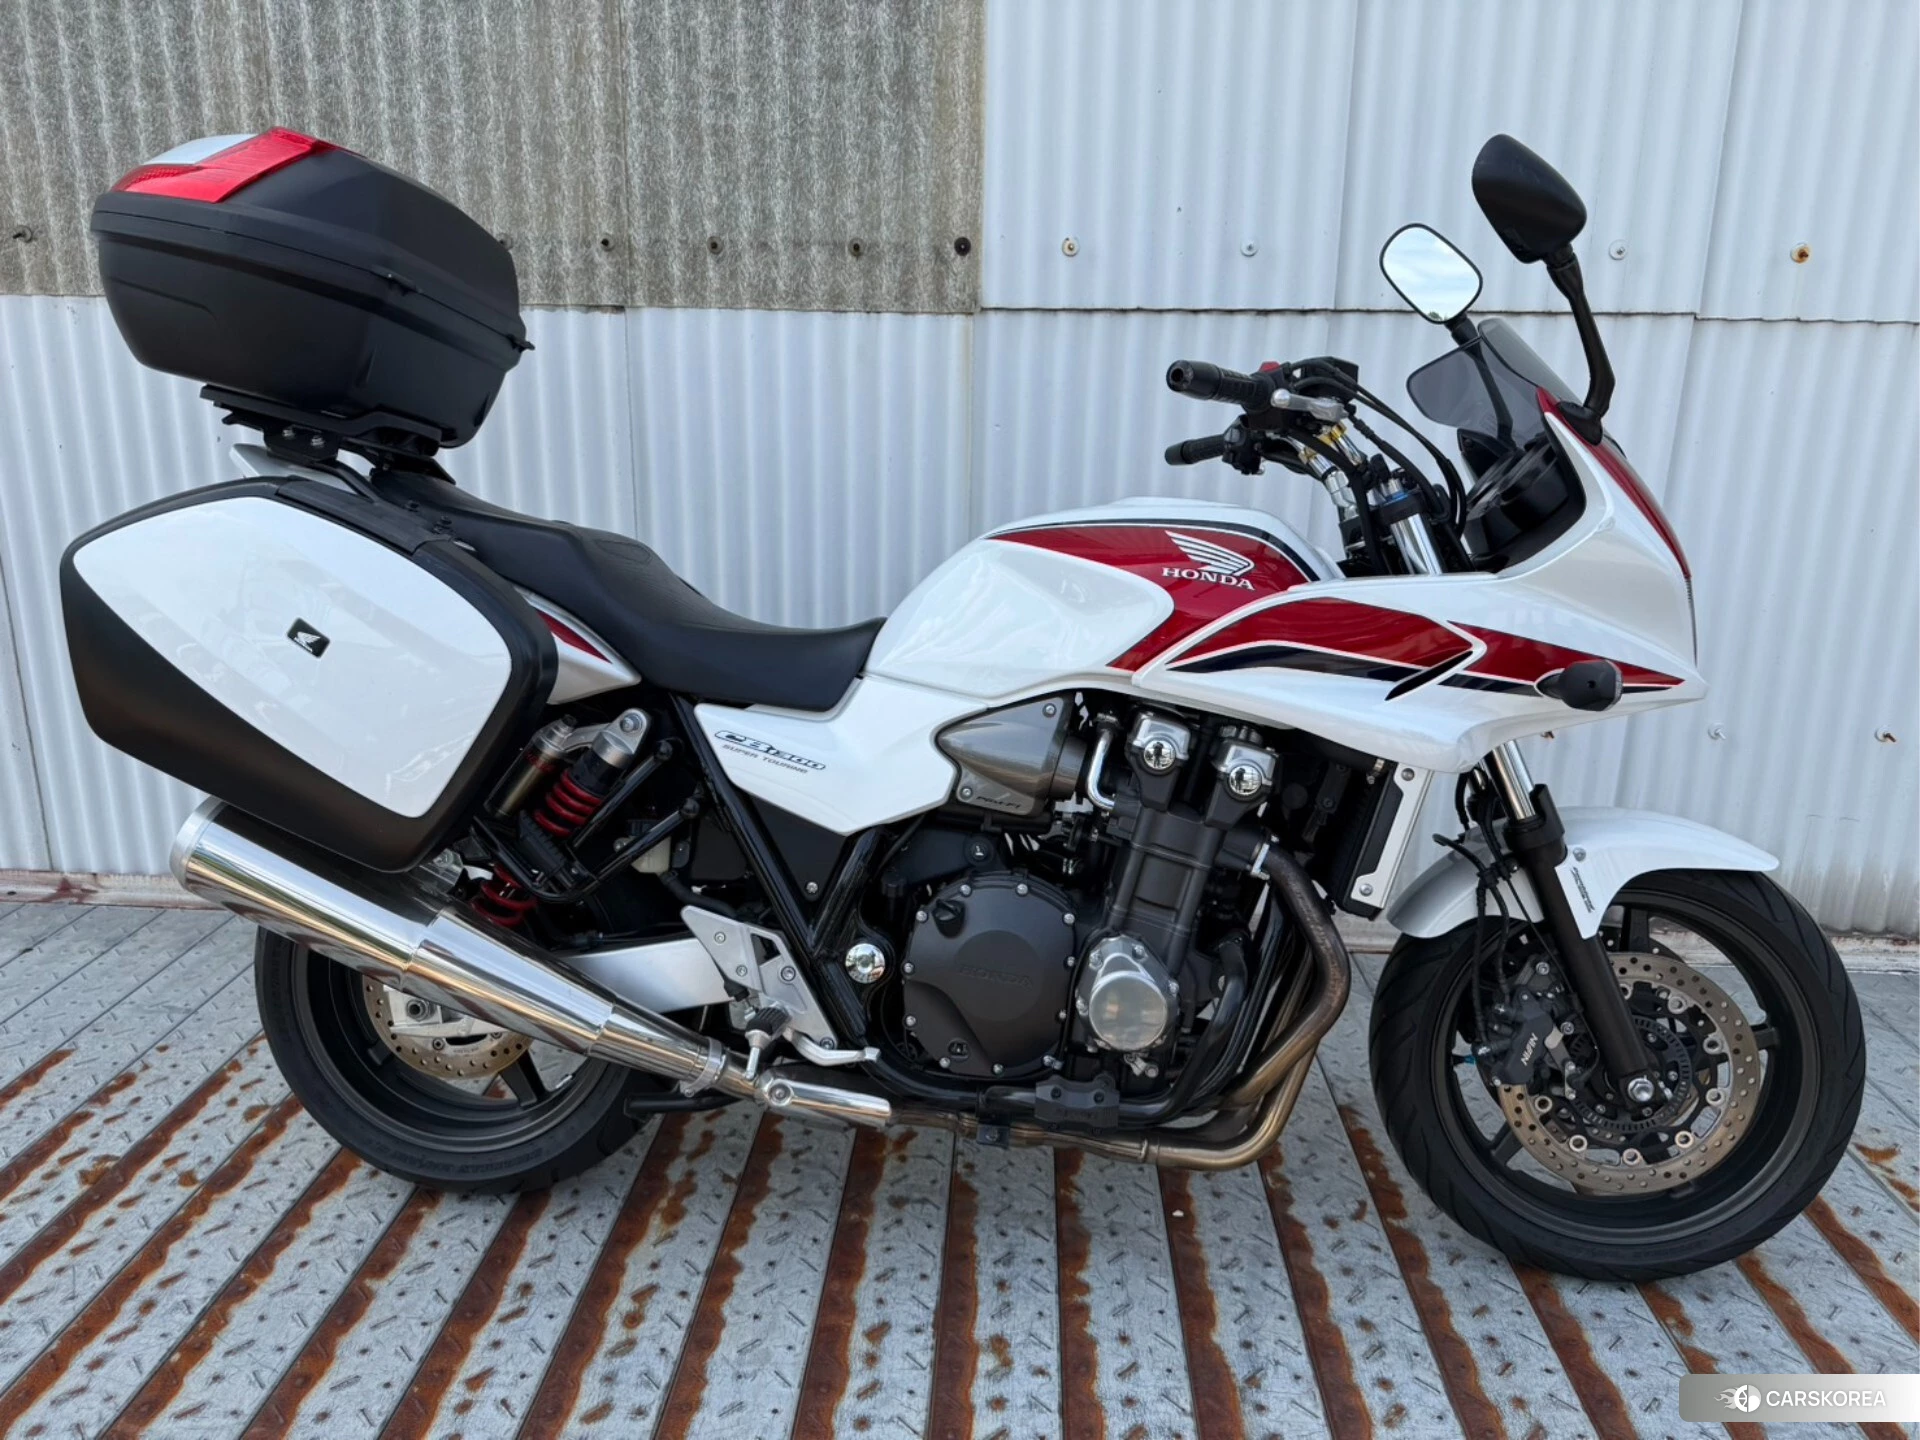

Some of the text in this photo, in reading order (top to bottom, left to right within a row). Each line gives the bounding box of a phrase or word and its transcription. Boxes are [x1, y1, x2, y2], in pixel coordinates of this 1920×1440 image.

[1162, 567, 1255, 591] HONDA
[722, 743, 808, 774] SUPER TOURING
[958, 964, 1033, 987] HONDA
